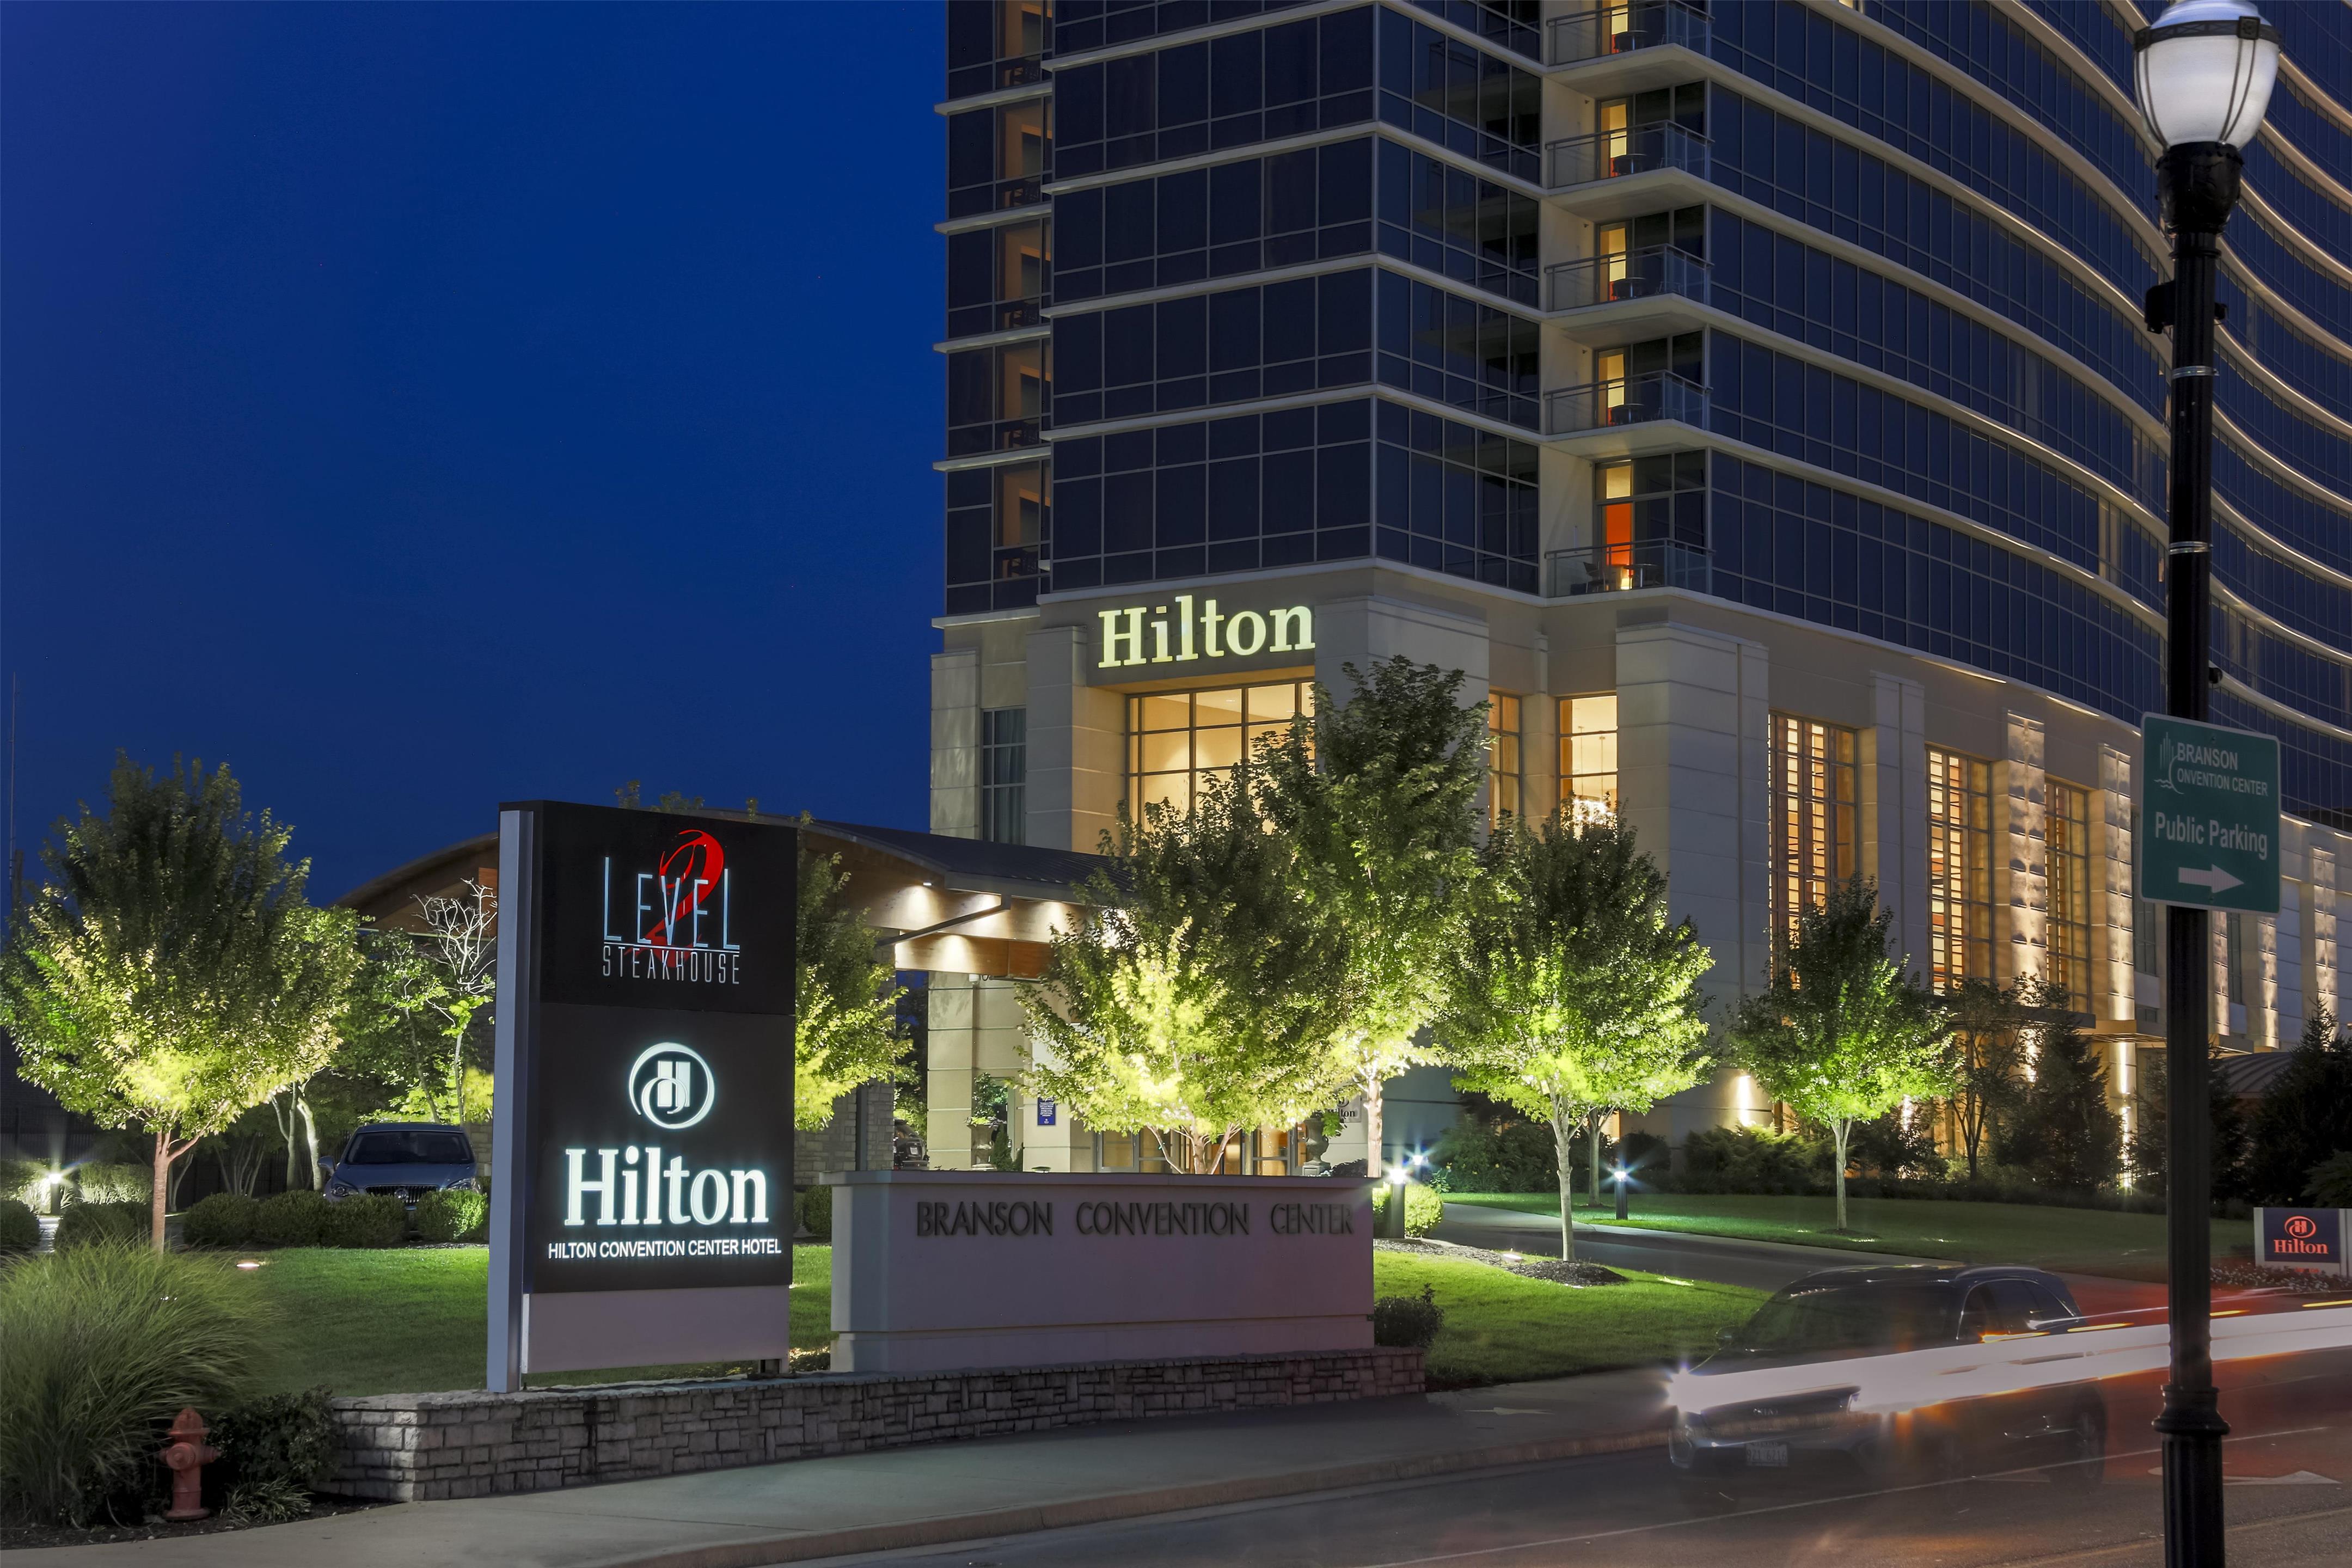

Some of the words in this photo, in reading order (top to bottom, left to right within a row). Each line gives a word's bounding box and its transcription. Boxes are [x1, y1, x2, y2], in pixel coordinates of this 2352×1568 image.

[1098, 595, 1316, 668] Hilton
[2177, 742, 2238, 770] BRANSON
[2232, 776, 2268, 797] CENTER
[2155, 811, 2204, 844] Public
[2209, 819, 2267, 860] Parking
[604, 856, 740, 950] LEVEL
[603, 945, 739, 984] STEAKHOUSE
[564, 1146, 769, 1226] Hilton
[917, 1201, 1053, 1236] BRANSON
[1076, 1201, 1250, 1236] CONVENTION
[1271, 1203, 1355, 1234] CENTER
[548, 1242, 597, 1259] HILTON
[599, 1240, 685, 1258] CONVENTION
[688, 1239, 739, 1256] CENTER
[742, 1238, 782, 1254] HOTEL
[2274, 1239, 2329, 1254] Hilton
